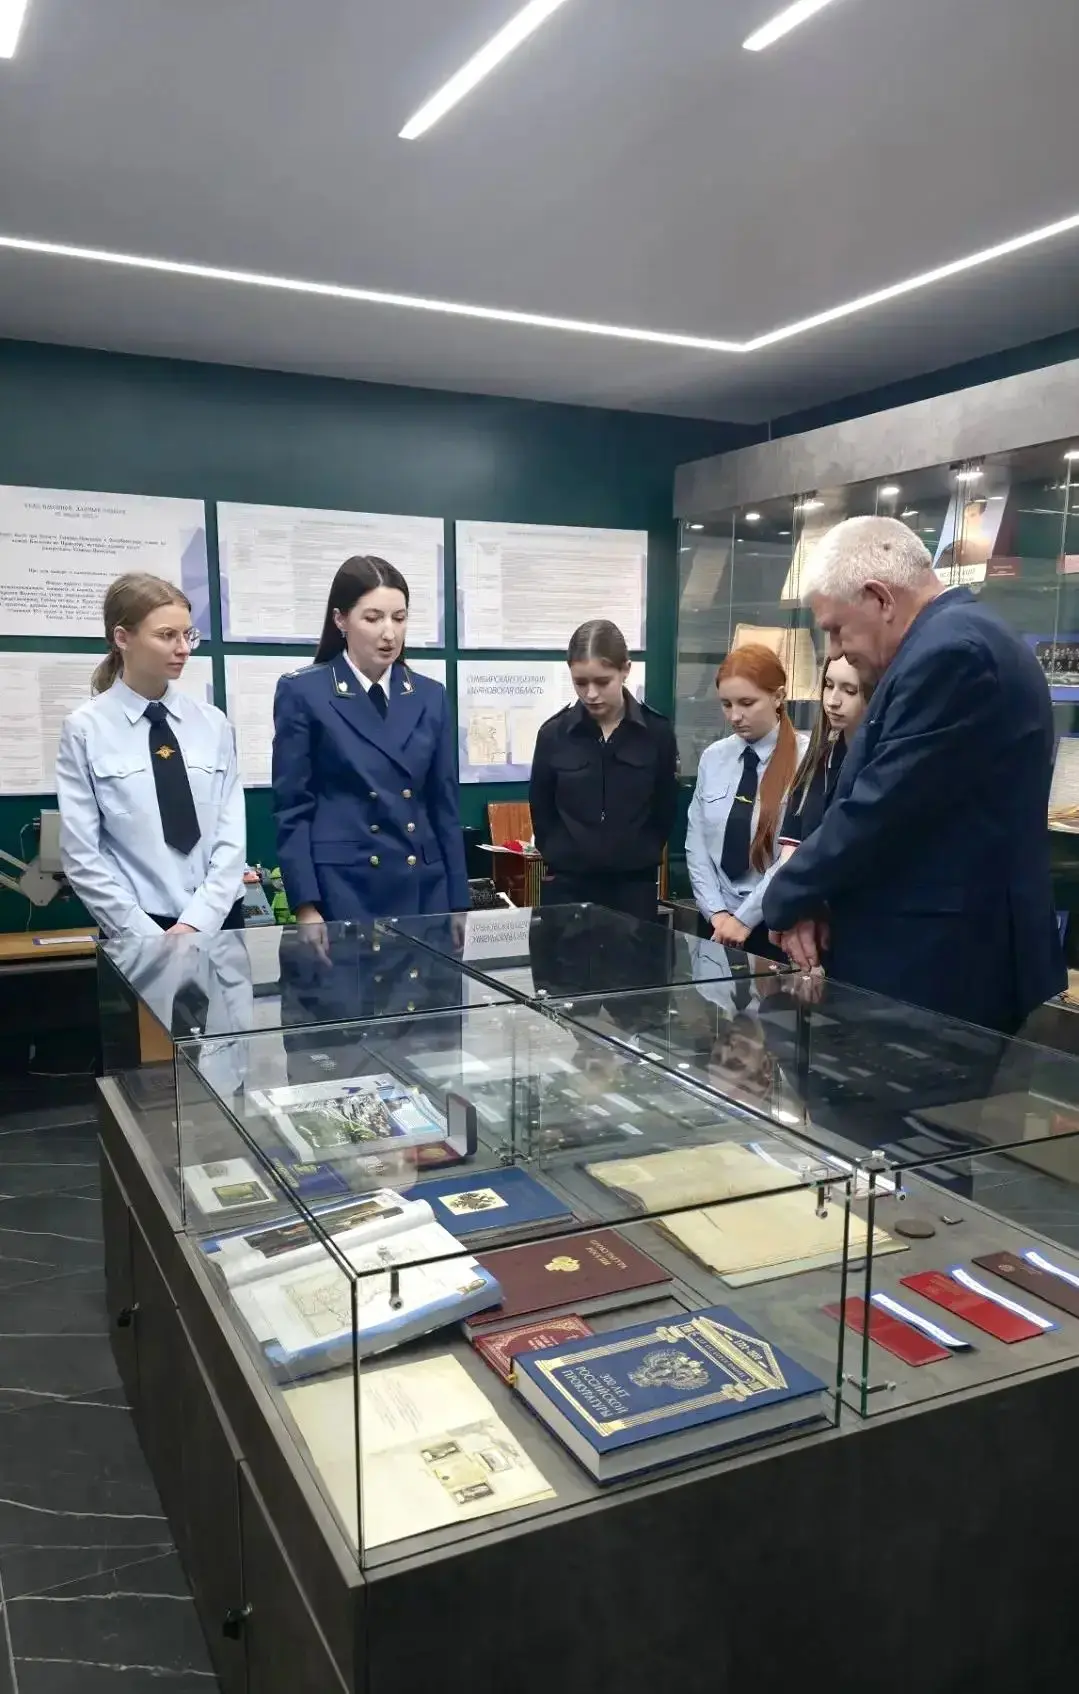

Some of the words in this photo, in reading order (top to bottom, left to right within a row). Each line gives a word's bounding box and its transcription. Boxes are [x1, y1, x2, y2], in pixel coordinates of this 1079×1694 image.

[561, 1369, 613, 1418] ПРОКУРАТУРЫ
[575, 1366, 629, 1414] РОССИЙСКОЙ
[611, 1385, 630, 1398] ЛЕТ
